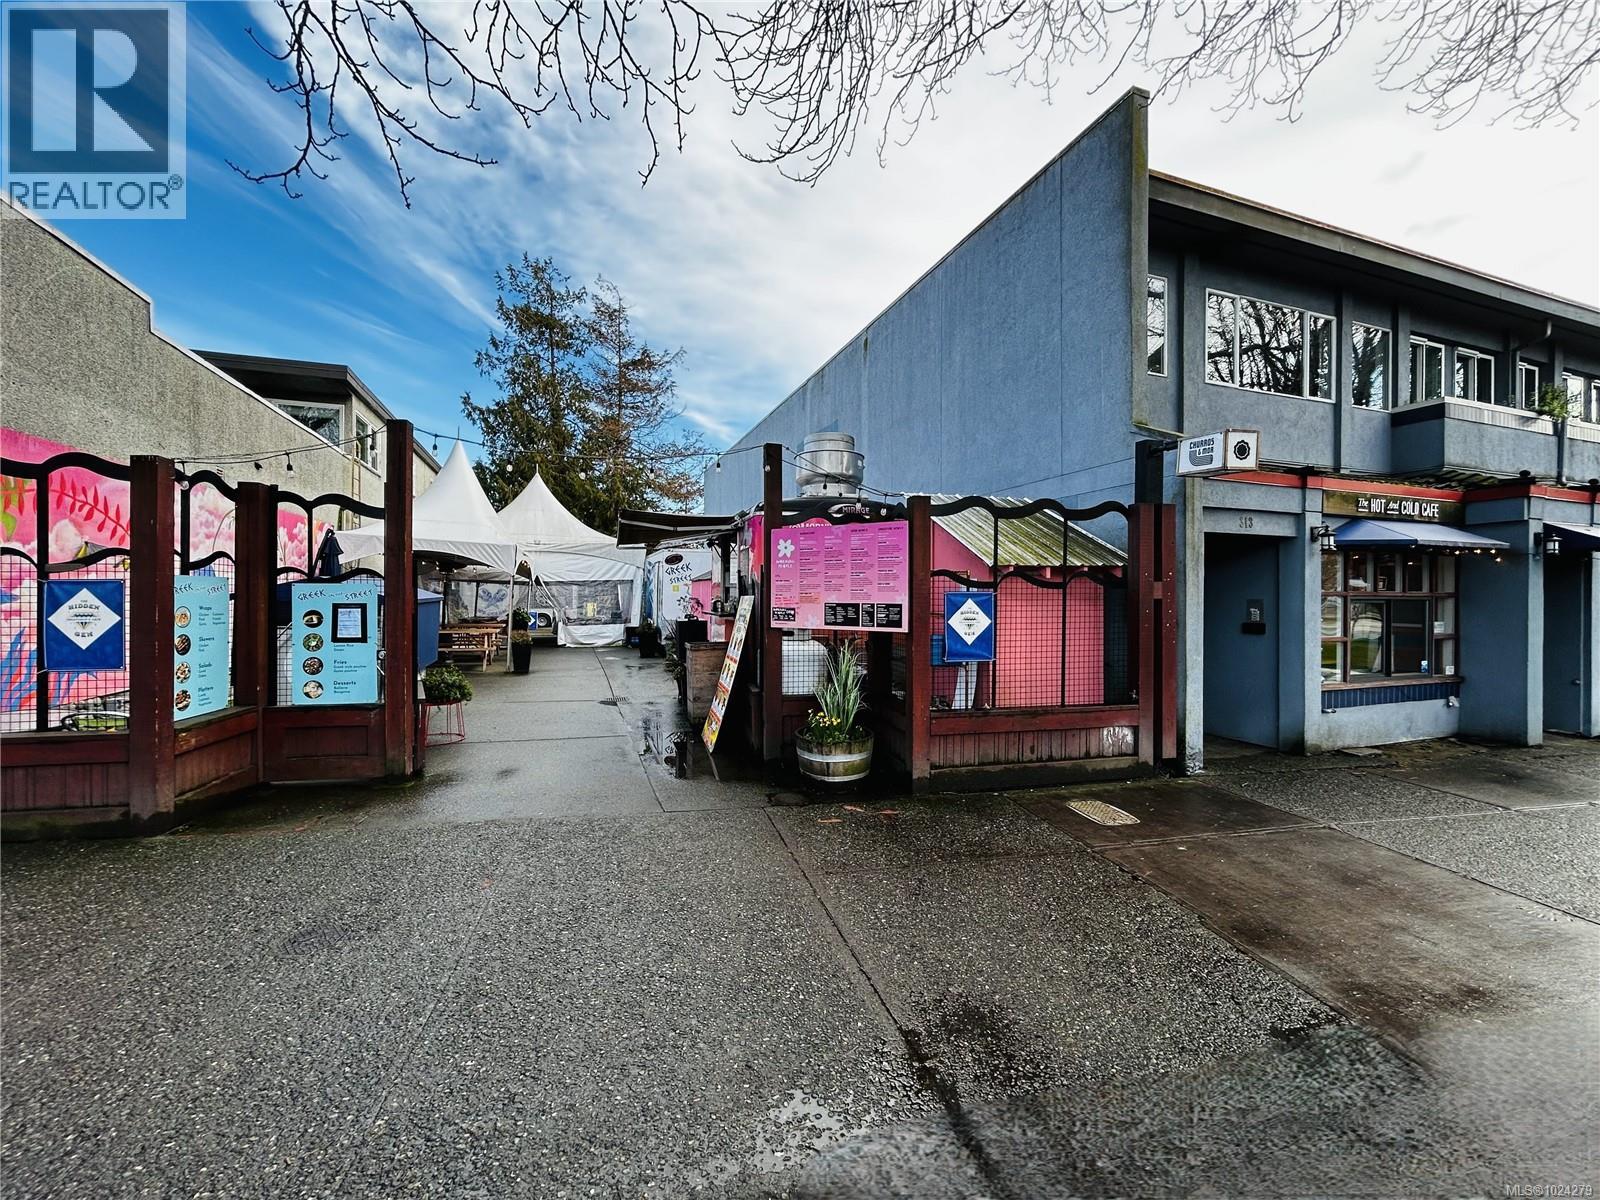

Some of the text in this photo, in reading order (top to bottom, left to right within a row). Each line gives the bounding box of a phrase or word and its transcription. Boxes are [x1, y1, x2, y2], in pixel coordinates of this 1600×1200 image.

[1189, 437, 1215, 450] CHURROS
[1357, 497, 1440, 517] The HOT And COLD CAFE
[665, 562, 693, 576] GREEK
[298, 589, 326, 600] GREEK
[345, 589, 373, 600] STREET
